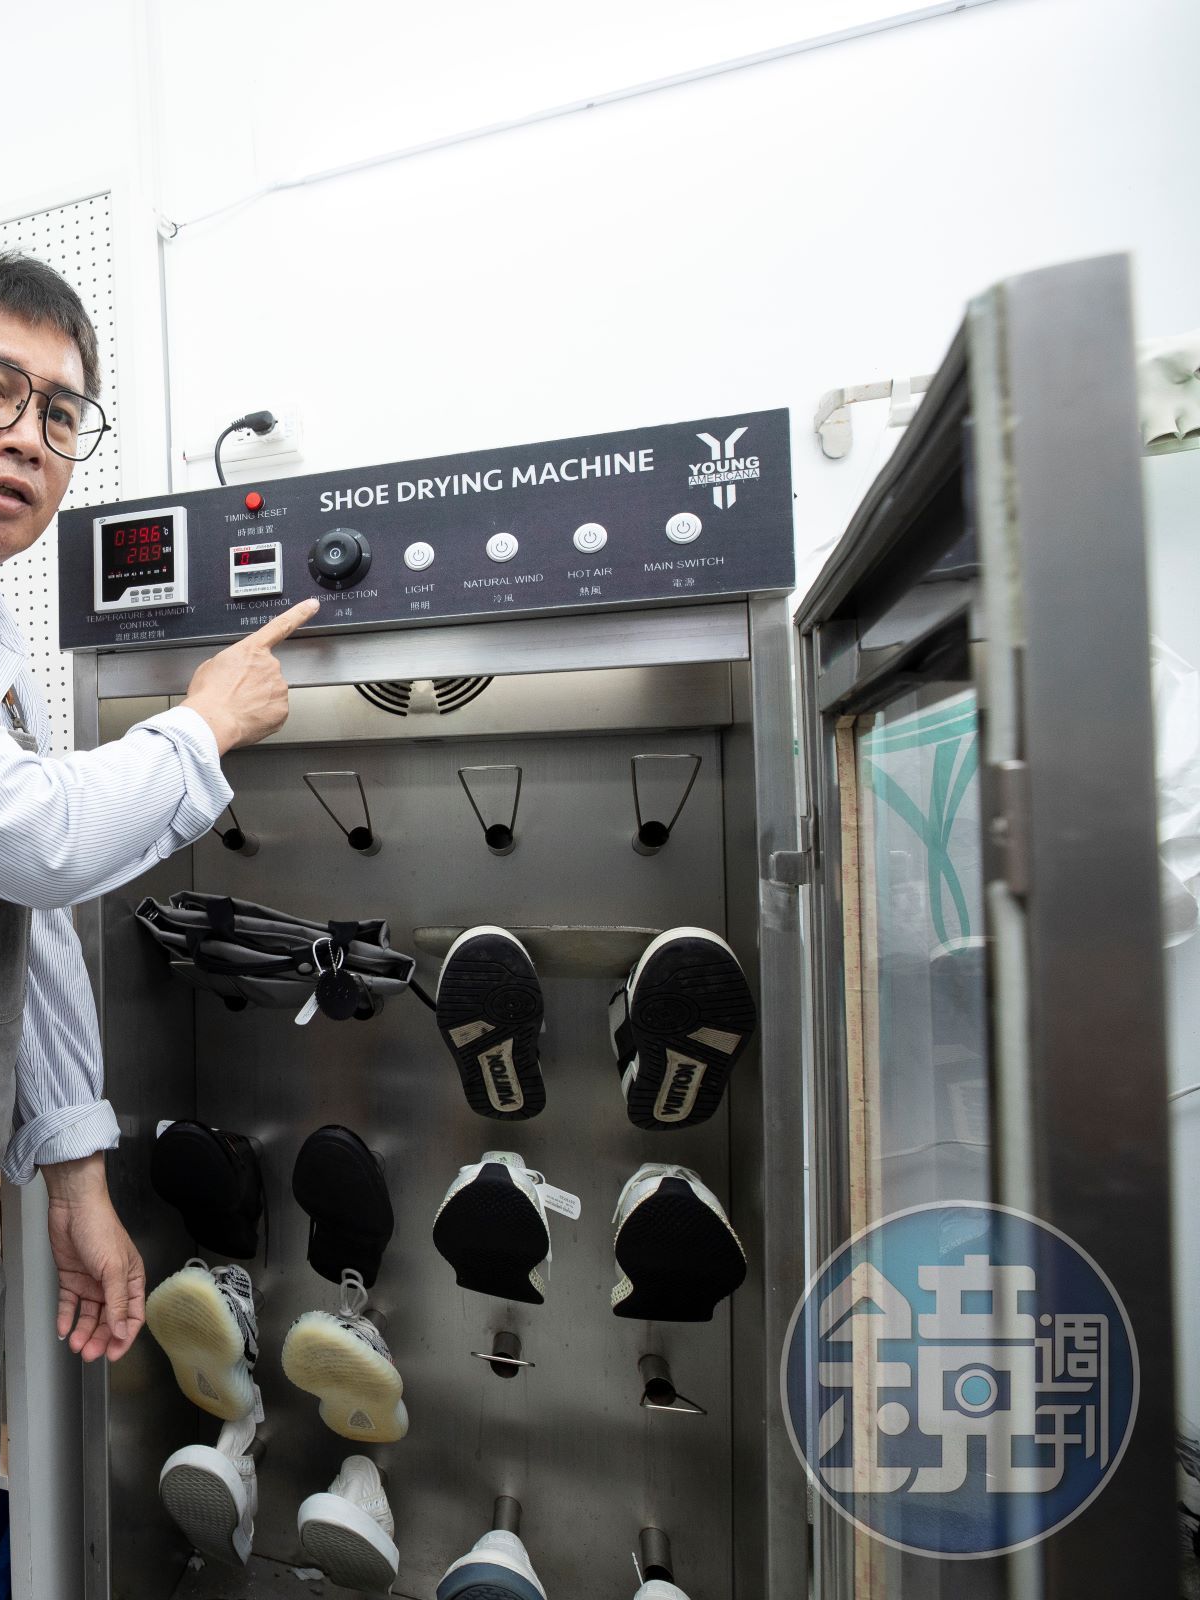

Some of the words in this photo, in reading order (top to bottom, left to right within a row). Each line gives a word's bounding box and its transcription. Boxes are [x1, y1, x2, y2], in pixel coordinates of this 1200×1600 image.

[688, 456, 760, 476] YOUNG
[319, 483, 389, 513] SHOE
[397, 469, 503, 503] DRYING
[511, 448, 655, 488] MACHINE
[688, 467, 760, 486] AMERICANA
[224, 512, 255, 523] TIMING
[257, 507, 288, 519] RESET
[644, 561, 674, 572] MAIN
[676, 555, 724, 569] SWITCH
[567, 569, 591, 579] HOT
[593, 567, 613, 576] AIR
[463, 577, 512, 589] NATURAL
[514, 573, 544, 584] WIND
[672, 577, 695, 588] 電源
[405, 583, 436, 594] LIGHT
[579, 585, 602, 596] 熱風
[225, 603, 246, 611] TIME
[248, 598, 293, 609] CONTROL
[493, 593, 514, 603] 冷風
[334, 607, 353, 617] 消毒
[410, 600, 431, 611] 照明
[86, 611, 145, 623] TEMPERATURE
[155, 606, 196, 617] HUMIDITY
[119, 620, 160, 630] CONTROL
[485, 1053, 518, 1107] VUITTON
[660, 1063, 698, 1116] VUITTON
